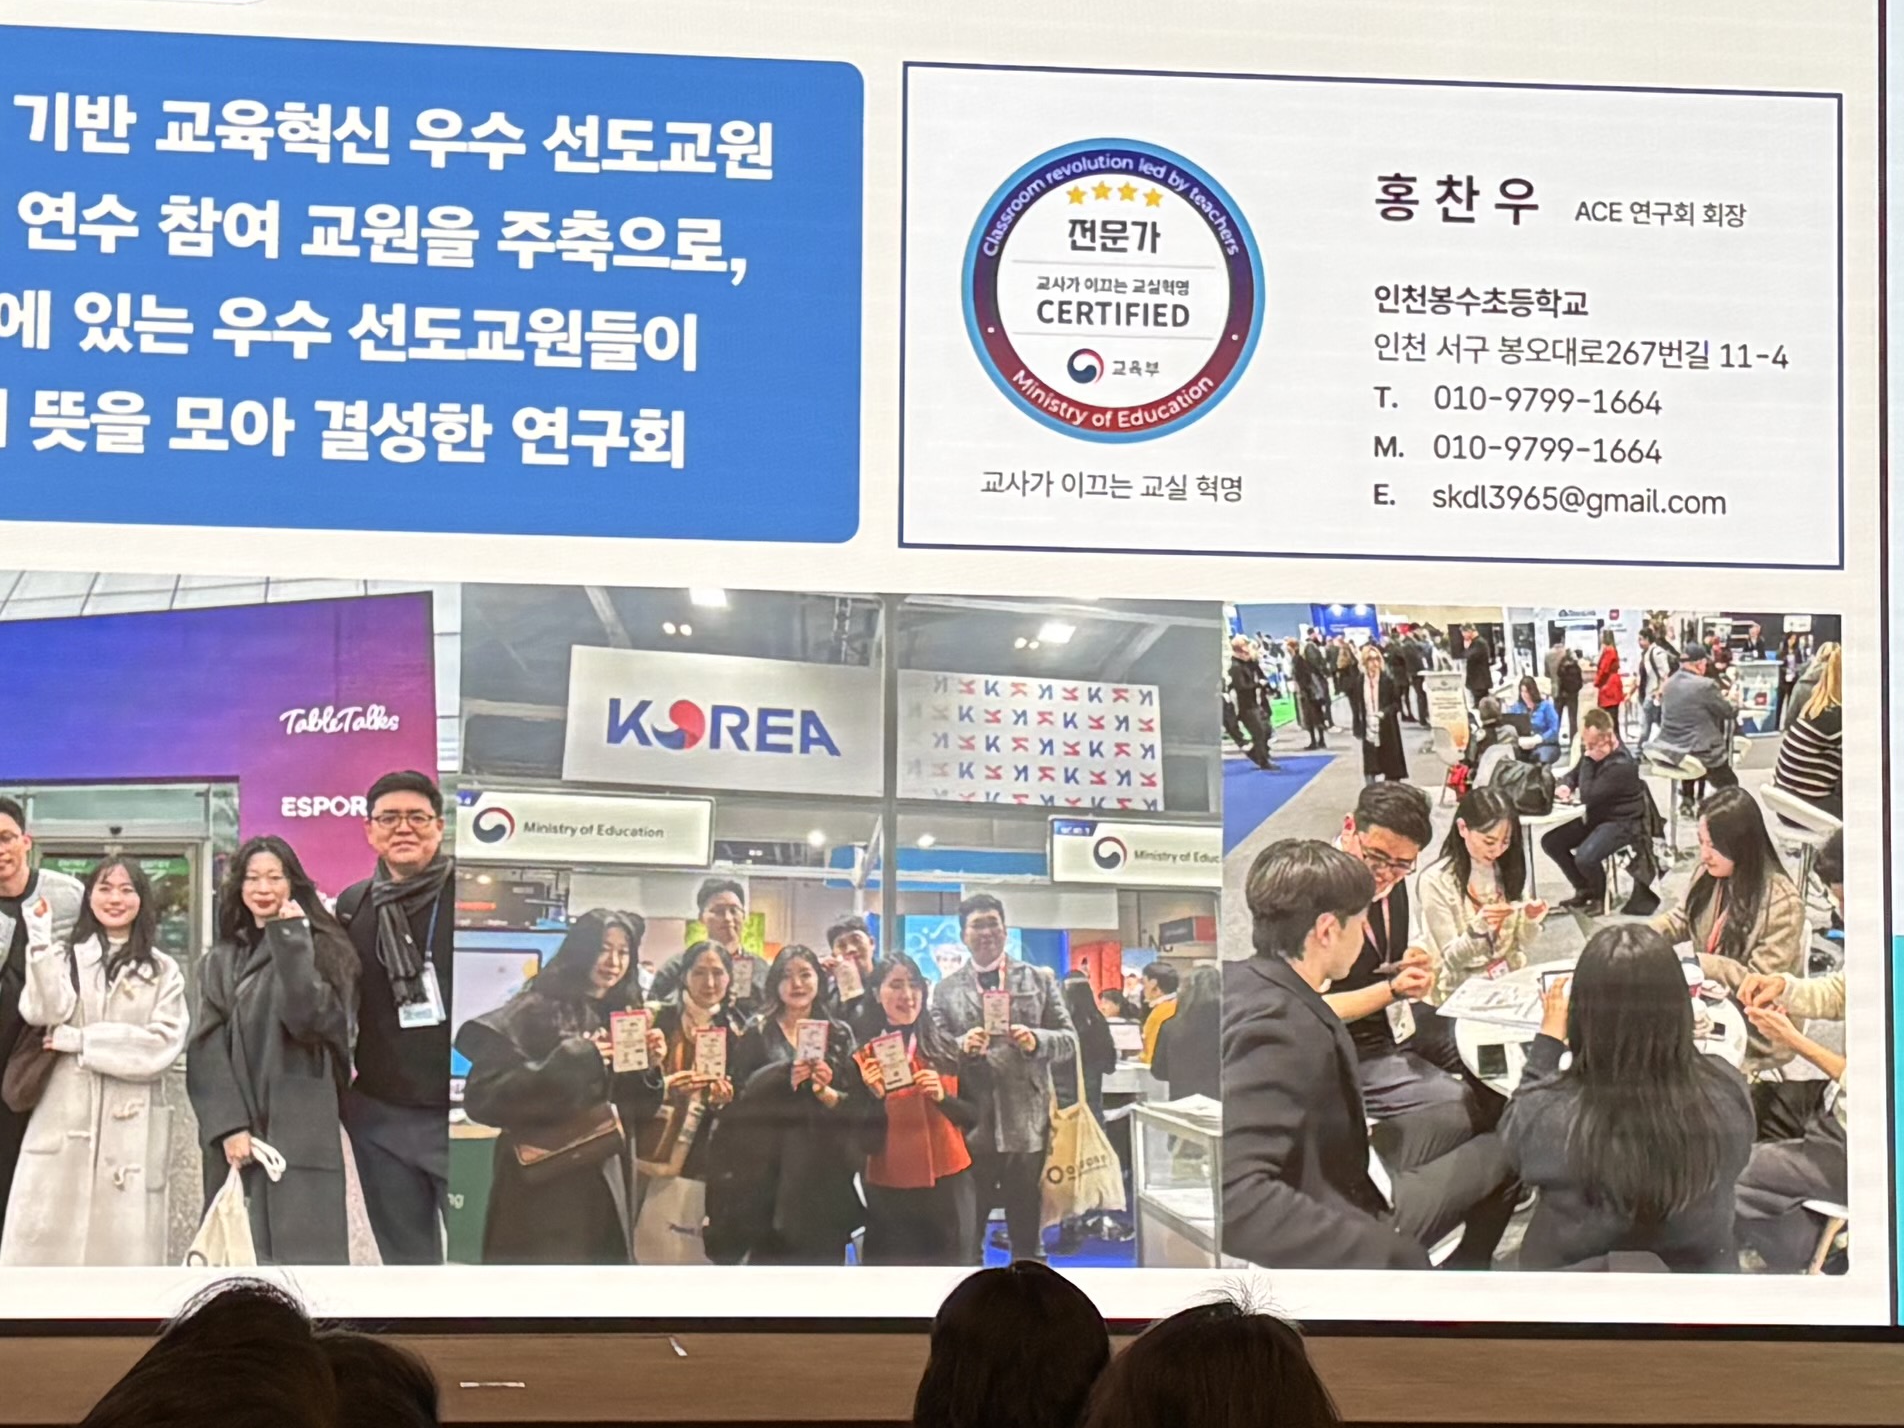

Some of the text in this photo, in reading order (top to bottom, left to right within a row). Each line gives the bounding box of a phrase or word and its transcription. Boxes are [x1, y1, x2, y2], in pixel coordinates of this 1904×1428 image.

[14, 92, 137, 154] 기반
[156, 100, 389, 165] 교육혁신
[410, 109, 526, 170] 우수
[543, 115, 772, 180] 선도교원
[983, 154, 1239, 257] Classroom revolution led by teachers
[1575, 201, 1622, 222] ACE
[1630, 201, 1693, 226] 연구회
[1703, 203, 1746, 227] 회장
[18, 191, 139, 253] 연수
[159, 195, 279, 259] 참여
[301, 204, 479, 268] 교원을
[498, 210, 746, 286] 주축으로,
[1069, 219, 1160, 253] 전문가
[1037, 276, 1080, 292] 교사가
[1085, 278, 1127, 294] 이끄는
[1375, 284, 1588, 318] 인천봉수초등학교
[1037, 300, 1189, 327] CERTIFIED
[74, 292, 193, 354] 있는
[213, 297, 331, 359] 우수
[348, 303, 697, 371] 선도교원들이
[1375, 332, 1788, 369] 인천 서구 봉오대로267번길 11-4
[1112, 360, 1159, 376] 교육부
[1013, 369, 1214, 428] Ministry of Education
[1374, 385, 1662, 414] T. 010-9799-1664
[30, 391, 151, 453] 뜻을
[169, 397, 295, 456] 모아
[320, 399, 492, 464] 결성한
[512, 407, 684, 468] 연구회
[1375, 435, 1662, 463] M. 010-9799-1664
[981, 470, 1241, 502] 교사가 이끄는 교실 혁명
[1374, 484, 1726, 518] E. skdl3965@gmail.com
[279, 704, 399, 735] TableTalks
[607, 698, 841, 756] KOREA
[524, 822, 664, 837] Ministry of Education
